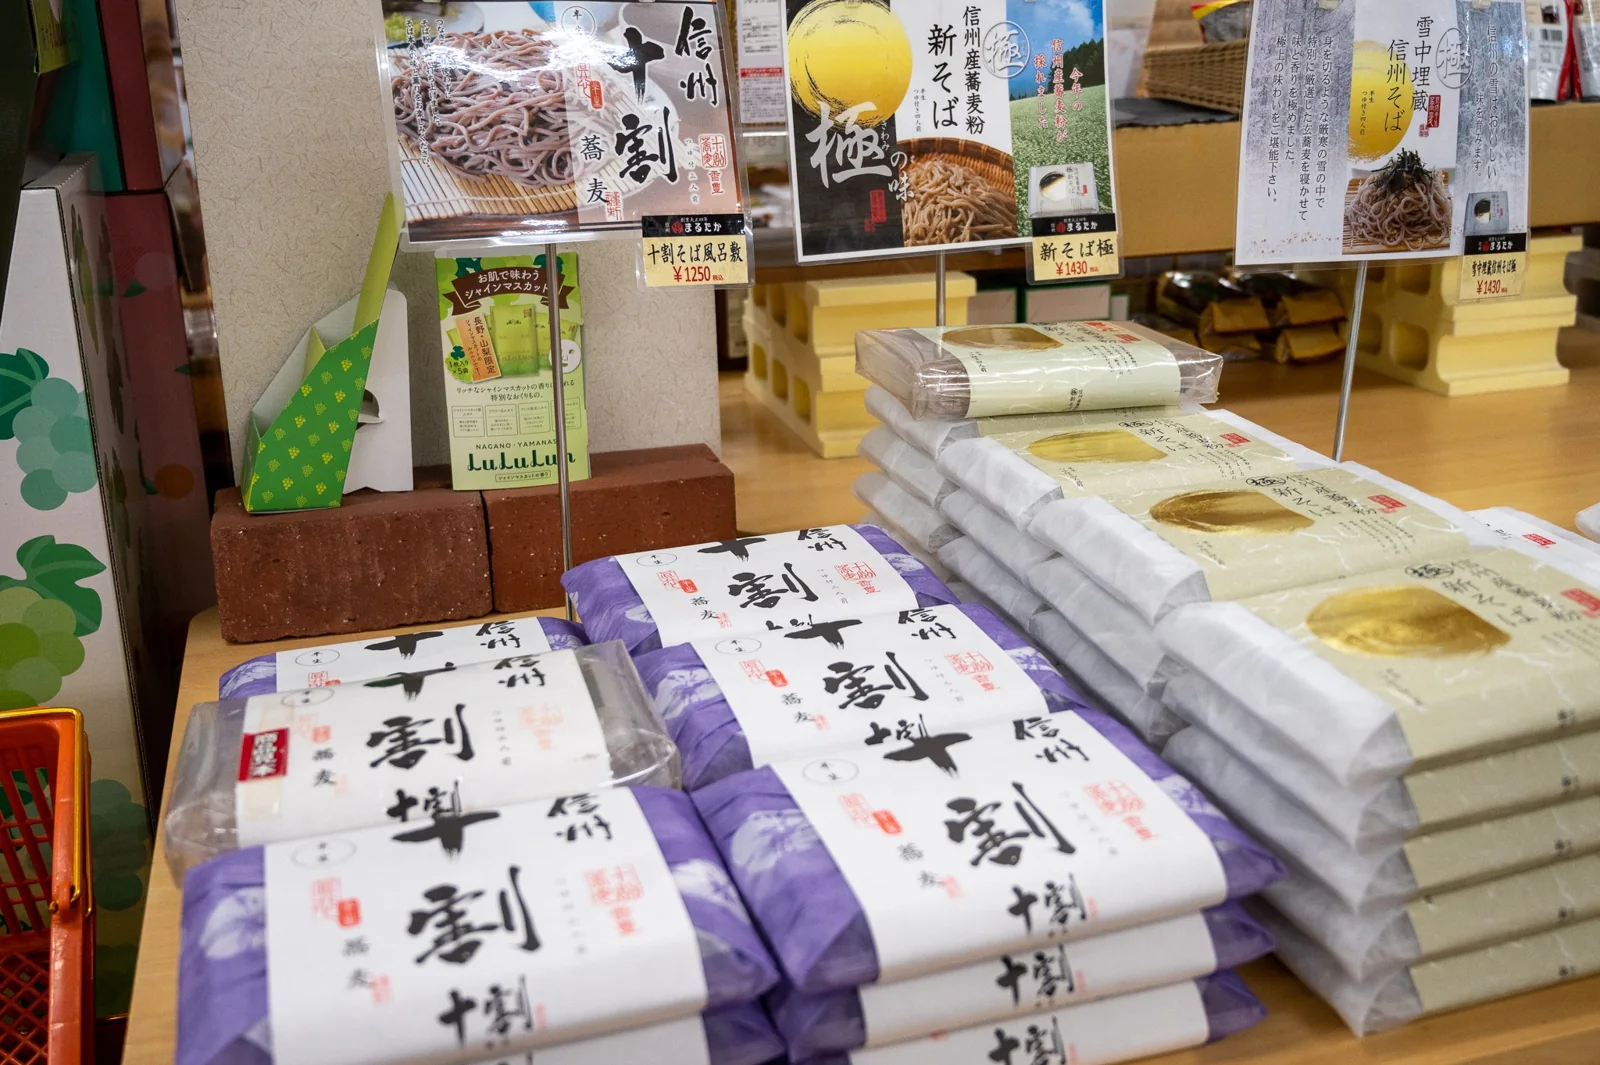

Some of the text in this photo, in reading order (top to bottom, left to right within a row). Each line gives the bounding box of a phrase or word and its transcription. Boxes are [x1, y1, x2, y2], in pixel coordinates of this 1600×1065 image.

[675, 6, 718, 105] 信州
[927, 24, 959, 130] 新そば
[963, 5, 985, 135] 信州産蕎麦粉
[1069, 66, 1085, 112] 今年の
[1384, 38, 1409, 132] 信州そば
[1410, 15, 1434, 112] 雪中埋蔵
[607, 27, 678, 183] 十割
[1033, 54, 1049, 129] 採れました
[1051, 39, 1068, 143] 信州産蕎麦粉が
[1267, 35, 1287, 203] 極上の味わいをご堪能下さい。
[1284, 35, 1301, 166] 味と香りを極めました。
[1315, 35, 1334, 208] 身を切るような厳寒の雪の中で
[805, 101, 893, 188] 極
[1298, 35, 1318, 221] 特別に厳選した玄蕎麦を寝かせて
[1473, 93, 1484, 177] 味を育みます。
[580, 134, 609, 204] 蕎麦
[888, 151, 915, 202] の味
[477, 268, 540, 284] お肌で味わう
[647, 240, 744, 265] 十割そば風呂敷
[672, 265, 711, 282] ¥1250
[1039, 238, 1115, 261] 新そば極
[1055, 260, 1088, 276] ¥1430
[1472, 259, 1517, 277] 雪中埋蔵信州そば極
[464, 280, 549, 299] シャインマスカット
[1476, 279, 1501, 295] ¥1430
[474, 316, 497, 375] 長野・山梨限定
[490, 391, 545, 402] 特別なおくりもの。
[475, 442, 511, 450] NAGANO
[498, 471, 549, 480] シャインマスカットの香り
[697, 536, 820, 609] 十割
[798, 528, 848, 551] 信州
[475, 620, 523, 649] 信州
[898, 608, 957, 641] 信州
[784, 618, 929, 710] 十割
[364, 661, 475, 770] 十割
[1013, 716, 1090, 763] 信州
[883, 731, 1076, 867] 十割
[392, 810, 542, 965] 十割
[1007, 872, 1087, 933] 十割
[995, 942, 1075, 1007] 十割
[438, 976, 533, 1048] 十割
